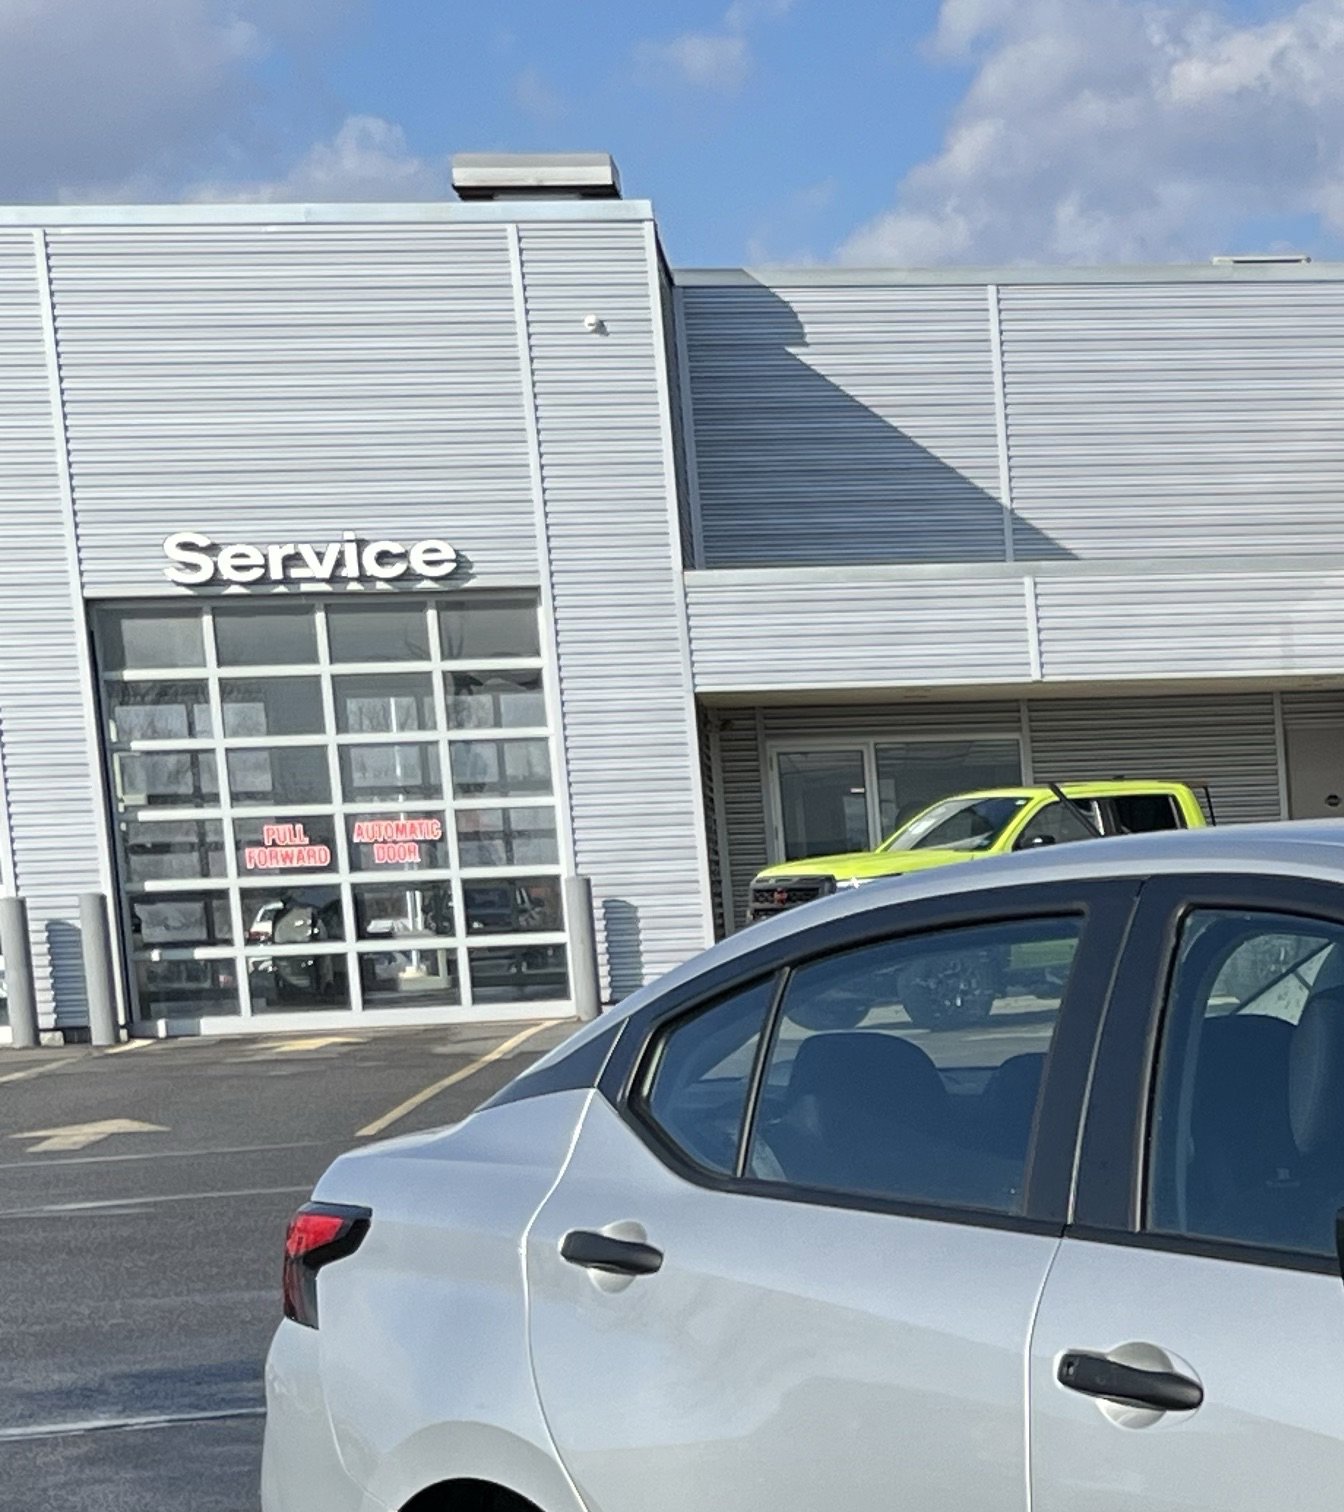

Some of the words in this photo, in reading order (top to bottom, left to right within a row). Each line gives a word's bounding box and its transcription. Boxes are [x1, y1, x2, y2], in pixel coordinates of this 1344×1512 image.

[162, 531, 457, 584] Service
[263, 824, 310, 845] PULL
[353, 819, 443, 842] AUTOMATIC
[245, 845, 331, 869] FORWARD
[373, 842, 421, 863] DOOR
